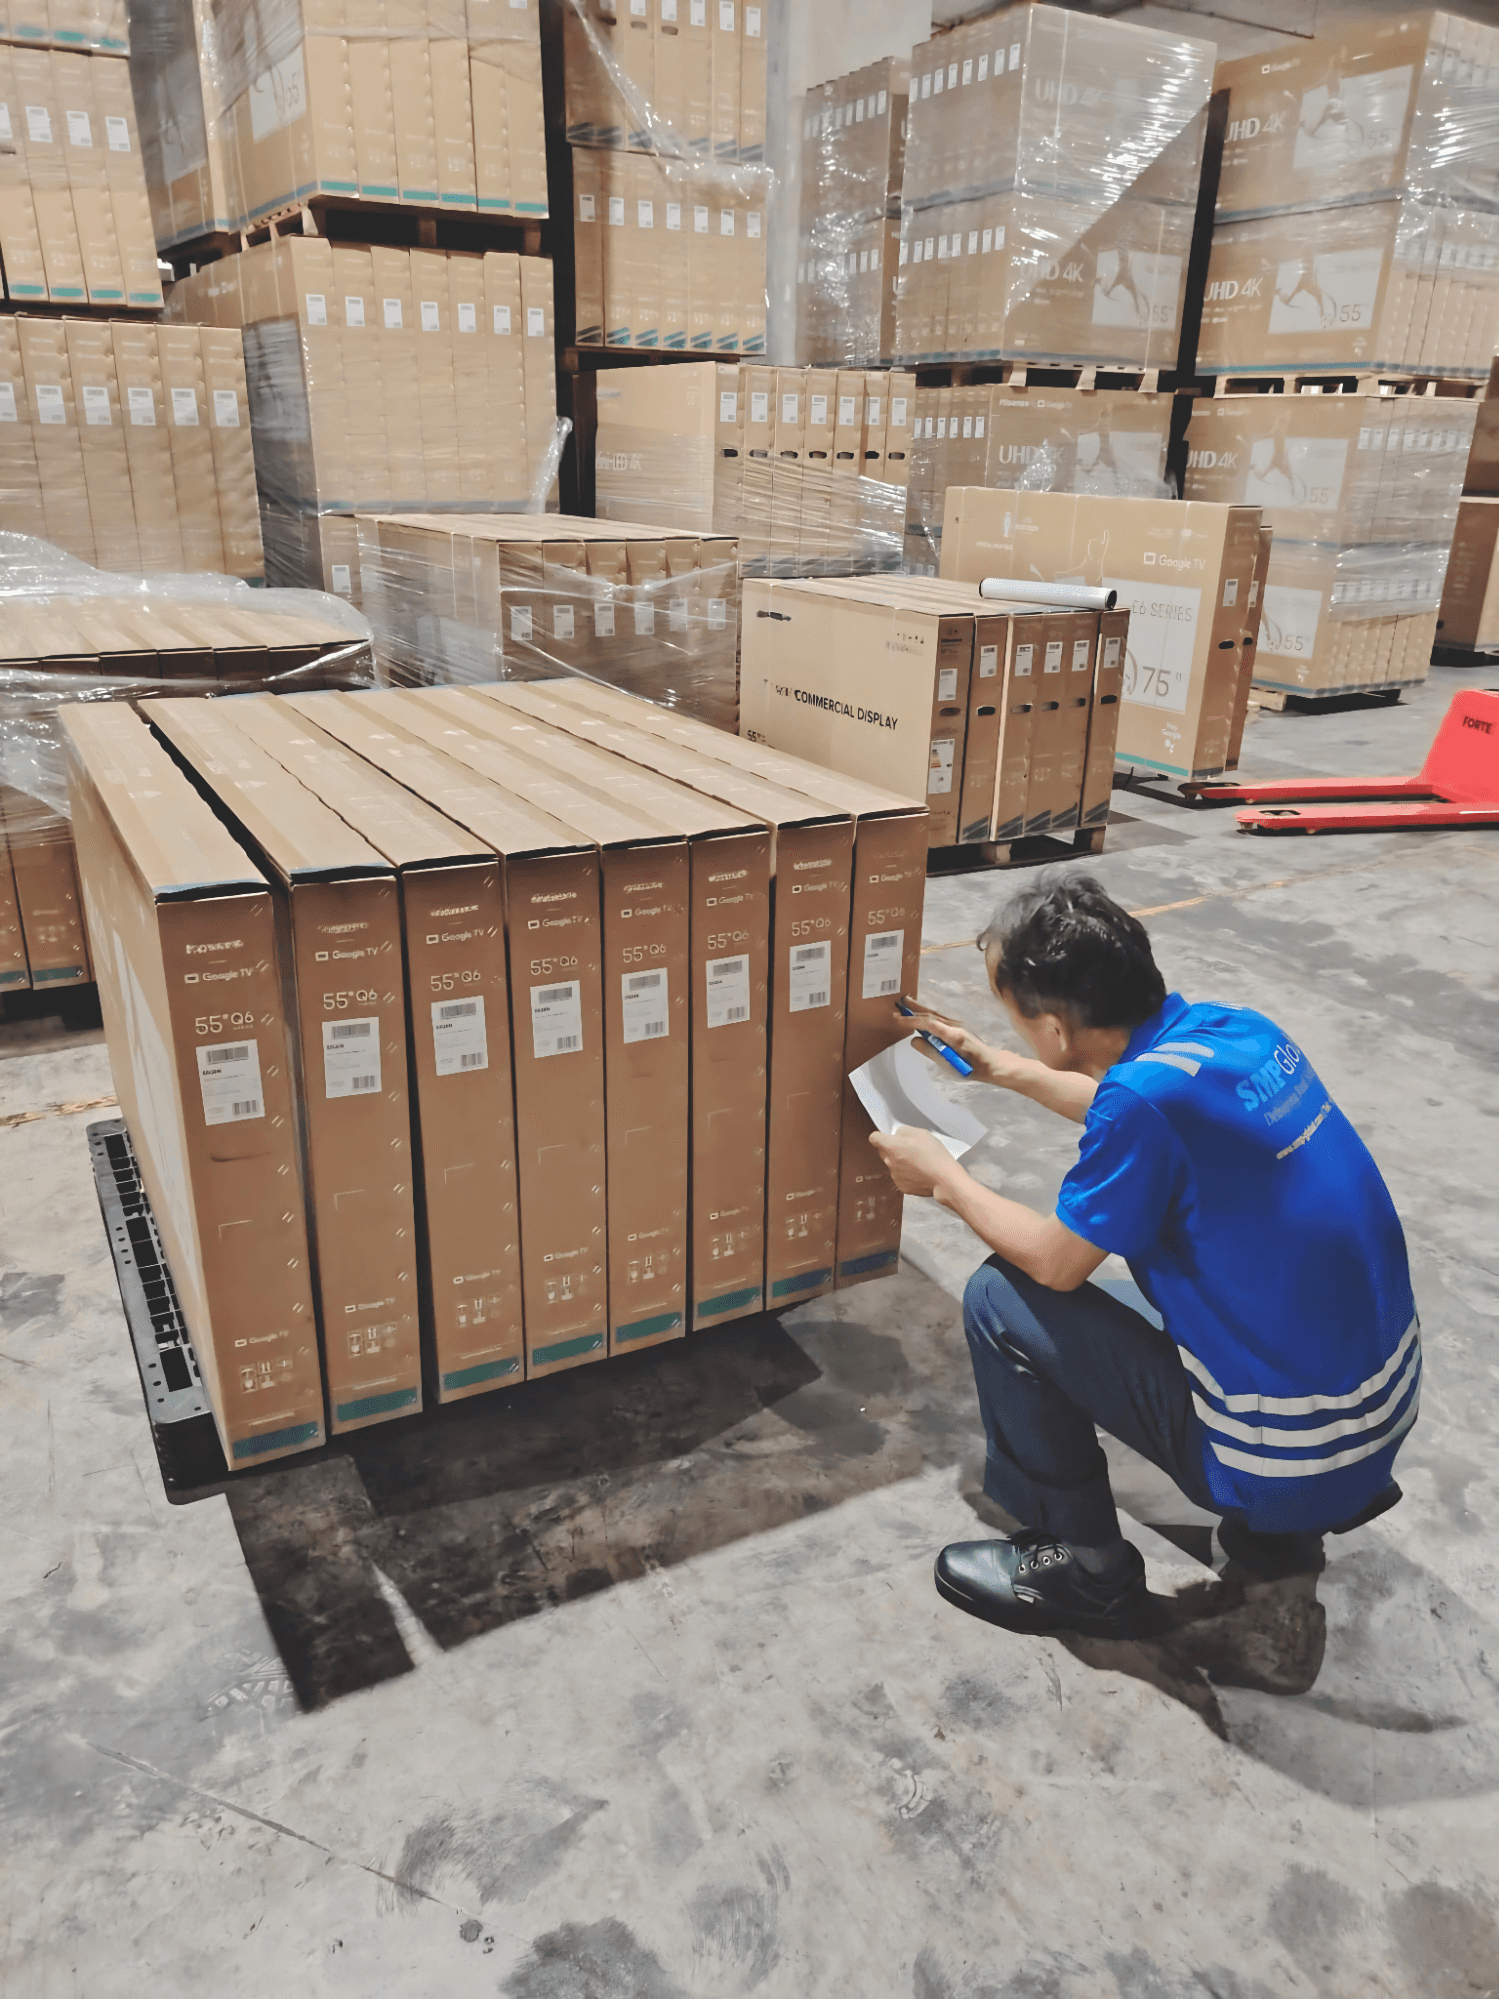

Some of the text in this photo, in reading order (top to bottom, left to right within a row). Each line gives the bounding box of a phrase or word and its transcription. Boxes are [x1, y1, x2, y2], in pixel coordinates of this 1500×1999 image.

[1262, 111, 1287, 134] 4K
[1063, 262, 1085, 283] 4K
[1241, 277, 1264, 298] 4K
[1218, 451, 1239, 469] 4K
[1158, 554, 1206, 571] Google TV
[1132, 599, 1193, 622] E6 SERIES
[794, 690, 898, 731] COMMERCIAL DISPLAY
[635, 906, 661, 916] Google
[442, 928, 485, 942] Google TV
[333, 947, 379, 960] Google TV
[240, 968, 253, 977] TV
[1235, 1043, 1301, 1112] SMPGlo
